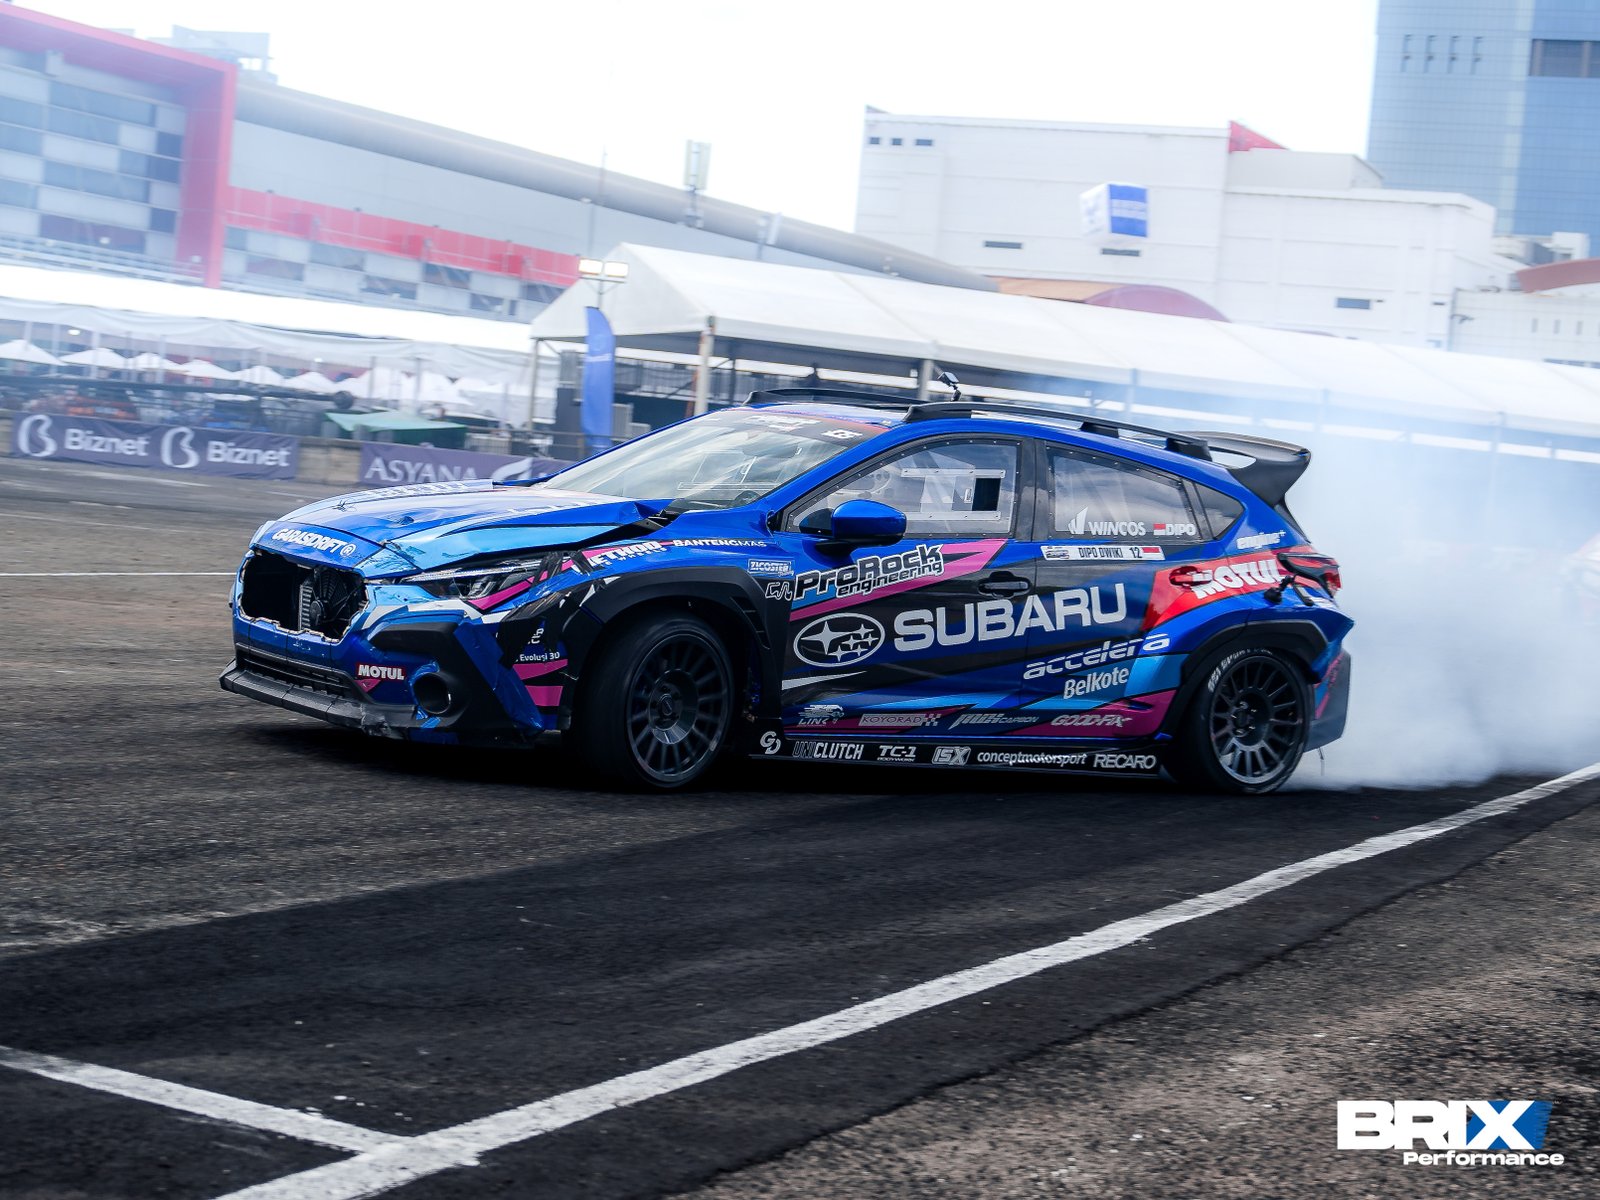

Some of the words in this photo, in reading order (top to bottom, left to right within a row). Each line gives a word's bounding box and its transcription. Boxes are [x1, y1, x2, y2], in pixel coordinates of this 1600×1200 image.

[64, 428, 150, 456] Biznet
[207, 441, 291, 467] Biznet
[364, 456, 477, 483] ASYANA
[1088, 521, 1147, 536] WINCOS
[1165, 523, 1196, 536] DIPO
[673, 538, 767, 548] BANTENGMAS
[572, 541, 662, 575] ETHOD
[1078, 547, 1097, 558] DIPO
[1100, 547, 1123, 558] DWIKI
[1129, 547, 1142, 559] 12
[794, 543, 944, 600] ProRock
[836, 557, 944, 598] engineering
[1190, 559, 1284, 599] MOTUL
[894, 583, 1127, 651] SUBARU
[549, 652, 560, 660] 3D
[1023, 634, 1170, 679] accelera
[358, 664, 405, 680] MOTUL
[862, 716, 922, 724] KOYORAD
[879, 745, 917, 758] TC-1
[977, 751, 1087, 767] conceptmotorsport
[1093, 753, 1157, 769] RECARO
